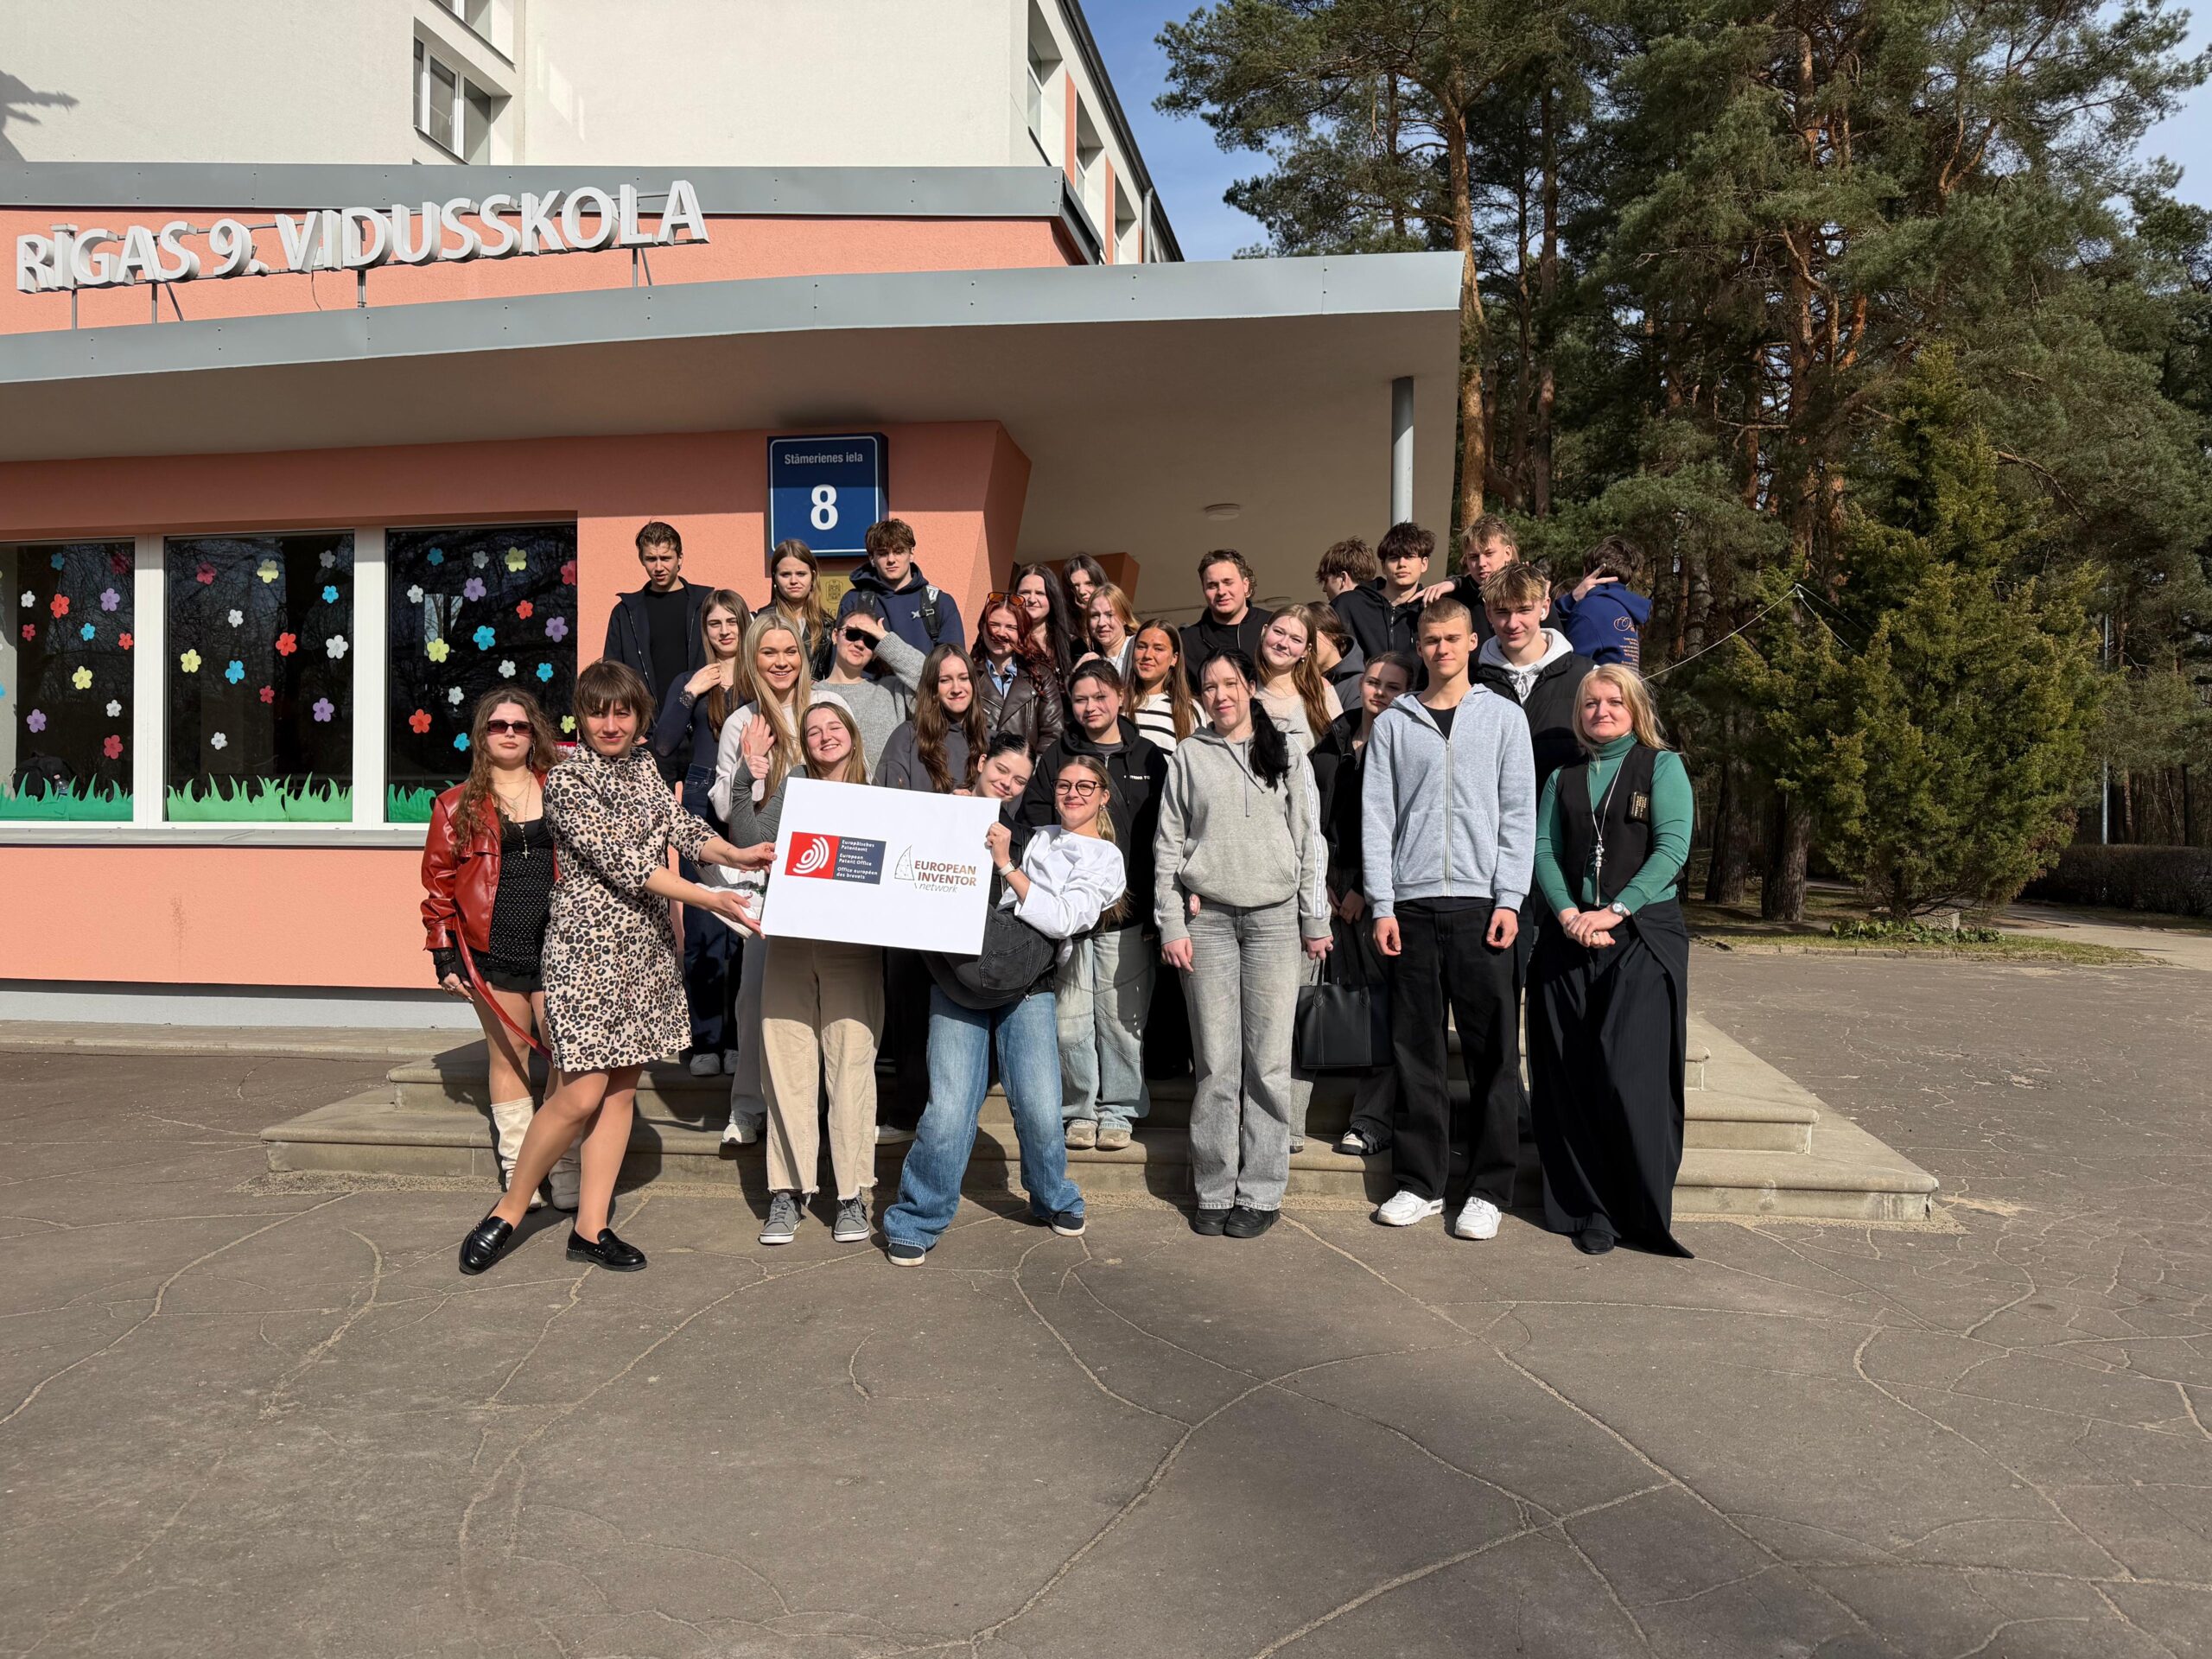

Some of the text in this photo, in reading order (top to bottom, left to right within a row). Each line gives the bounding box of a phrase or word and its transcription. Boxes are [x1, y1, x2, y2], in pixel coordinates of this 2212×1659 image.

[15, 180, 709, 294] RĪGAS 9. VIDUSSKOLA
[785, 452, 863, 466] Stāmerienes iela
[810, 484, 838, 531] 8
[842, 839, 874, 848] Europäisches
[914, 860, 976, 875] EUROPEAN
[918, 871, 976, 887] INVENTOR
[918, 881, 958, 893] network
